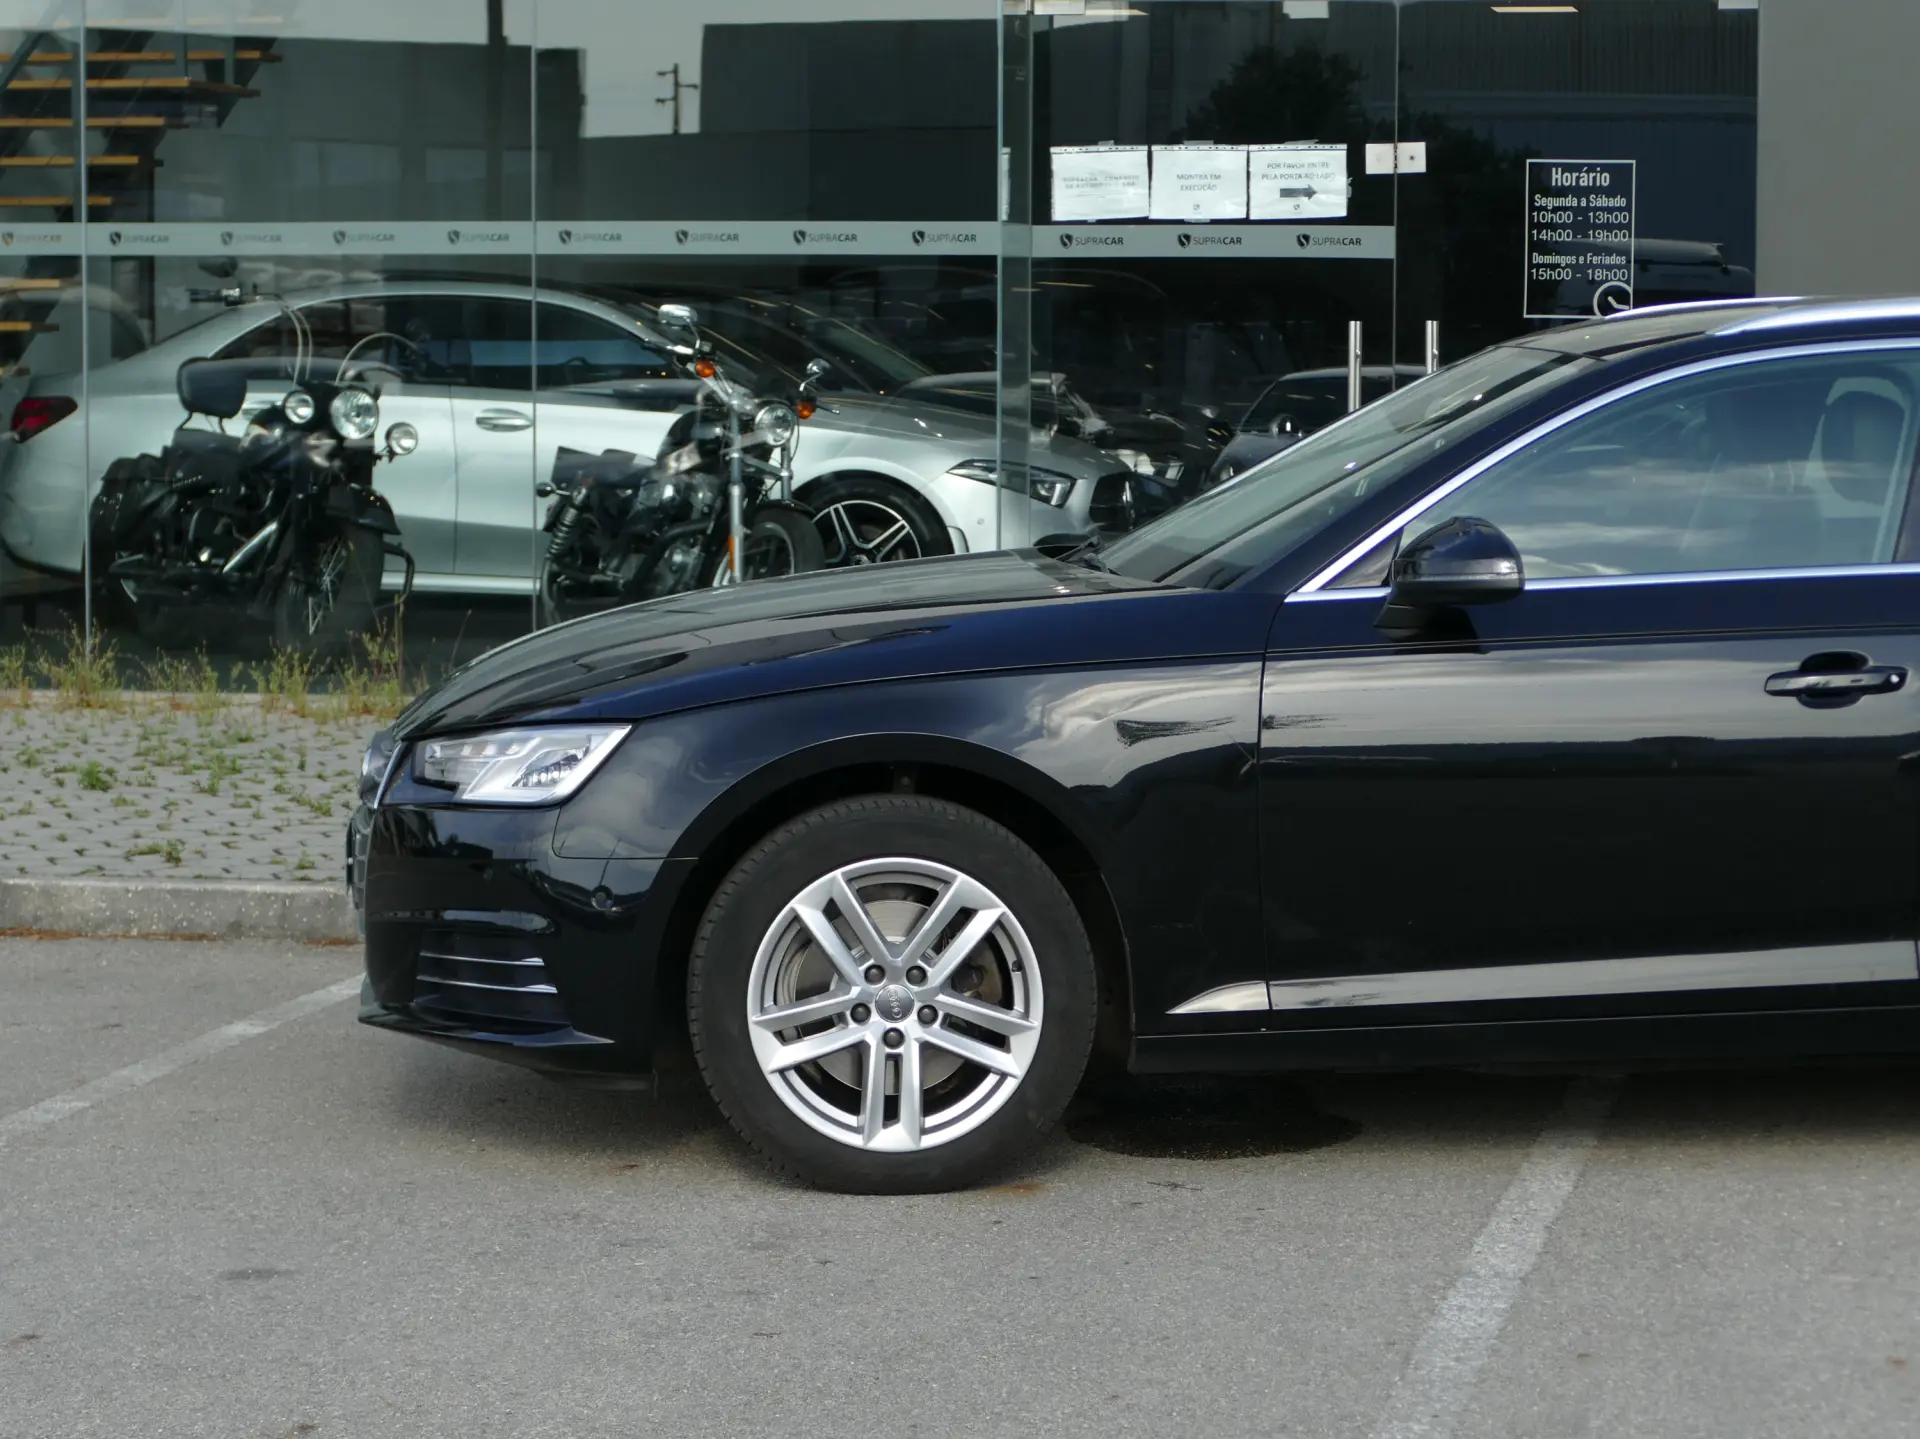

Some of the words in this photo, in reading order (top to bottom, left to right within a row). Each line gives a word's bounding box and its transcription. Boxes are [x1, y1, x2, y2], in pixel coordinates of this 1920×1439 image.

[1551, 166, 1610, 187] Horário
[1180, 183, 1217, 191] EXECUÇÃO
[1534, 194, 1577, 209] Segunda
[1580, 198, 1586, 206] a
[1589, 194, 1626, 207] Sábado
[1532, 211, 1573, 223] 10h00
[1588, 212, 1629, 223] 13h00
[573, 232, 622, 242] SUPRACAR
[690, 233, 739, 242] SUPRACAR
[808, 233, 857, 243] SUPRACAR
[926, 233, 977, 243] SUPRACAR
[1532, 230, 1573, 241] 14h00
[1588, 230, 1629, 241] 19h00
[1074, 236, 1124, 246] SUPRACAR
[1193, 236, 1242, 246] SUPRACAR
[1311, 237, 1362, 246] SUPRACAR
[1532, 252, 1577, 267] Domingos
[1579, 256, 1585, 264] e
[1587, 253, 1627, 265] Feriados
[1531, 268, 1572, 280] 15h00
[1587, 269, 1628, 281] 18h00
